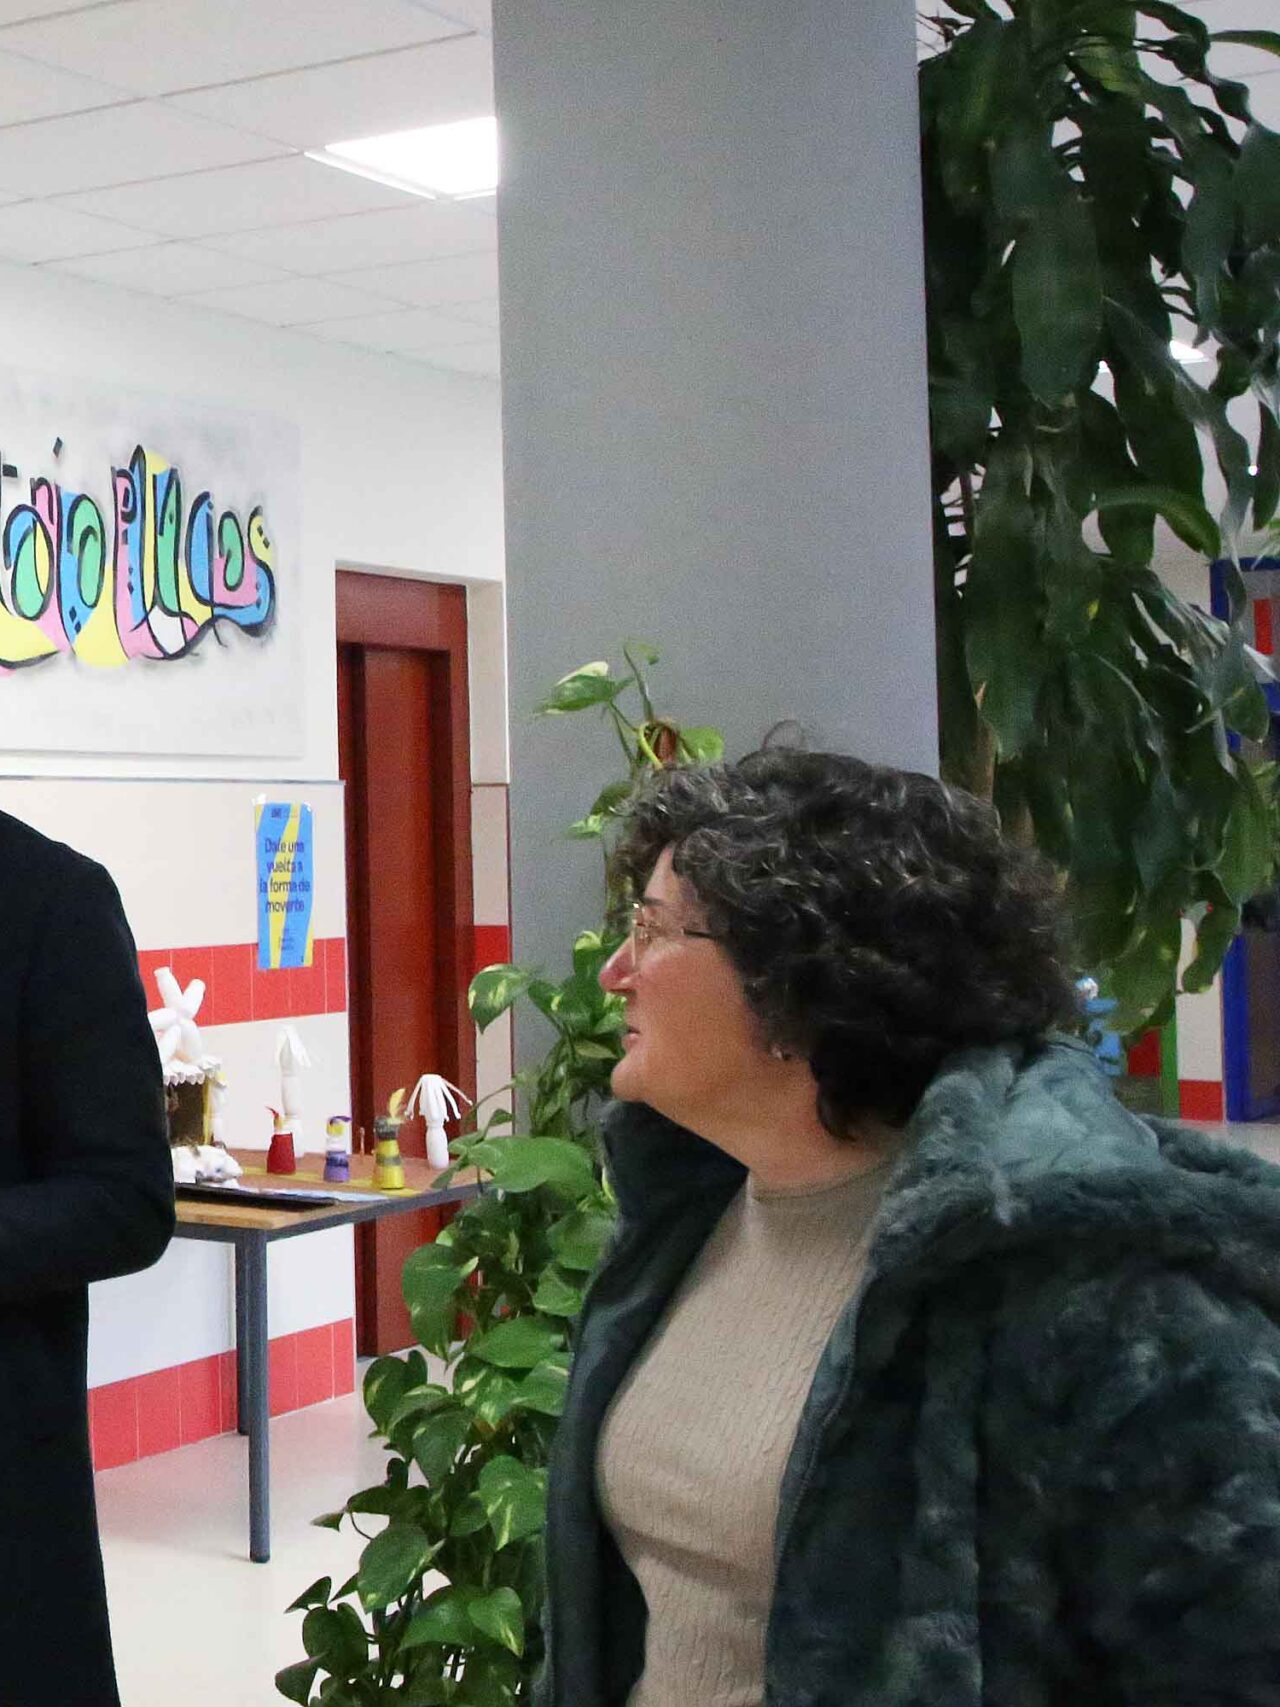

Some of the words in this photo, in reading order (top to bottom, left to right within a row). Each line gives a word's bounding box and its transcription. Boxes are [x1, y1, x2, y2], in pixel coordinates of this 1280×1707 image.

[265, 838, 287, 853] Dale
[288, 841, 305, 853] una
[266, 858, 297, 874] vuelta
[270, 877, 297, 893] forma
[298, 879, 311, 892] de
